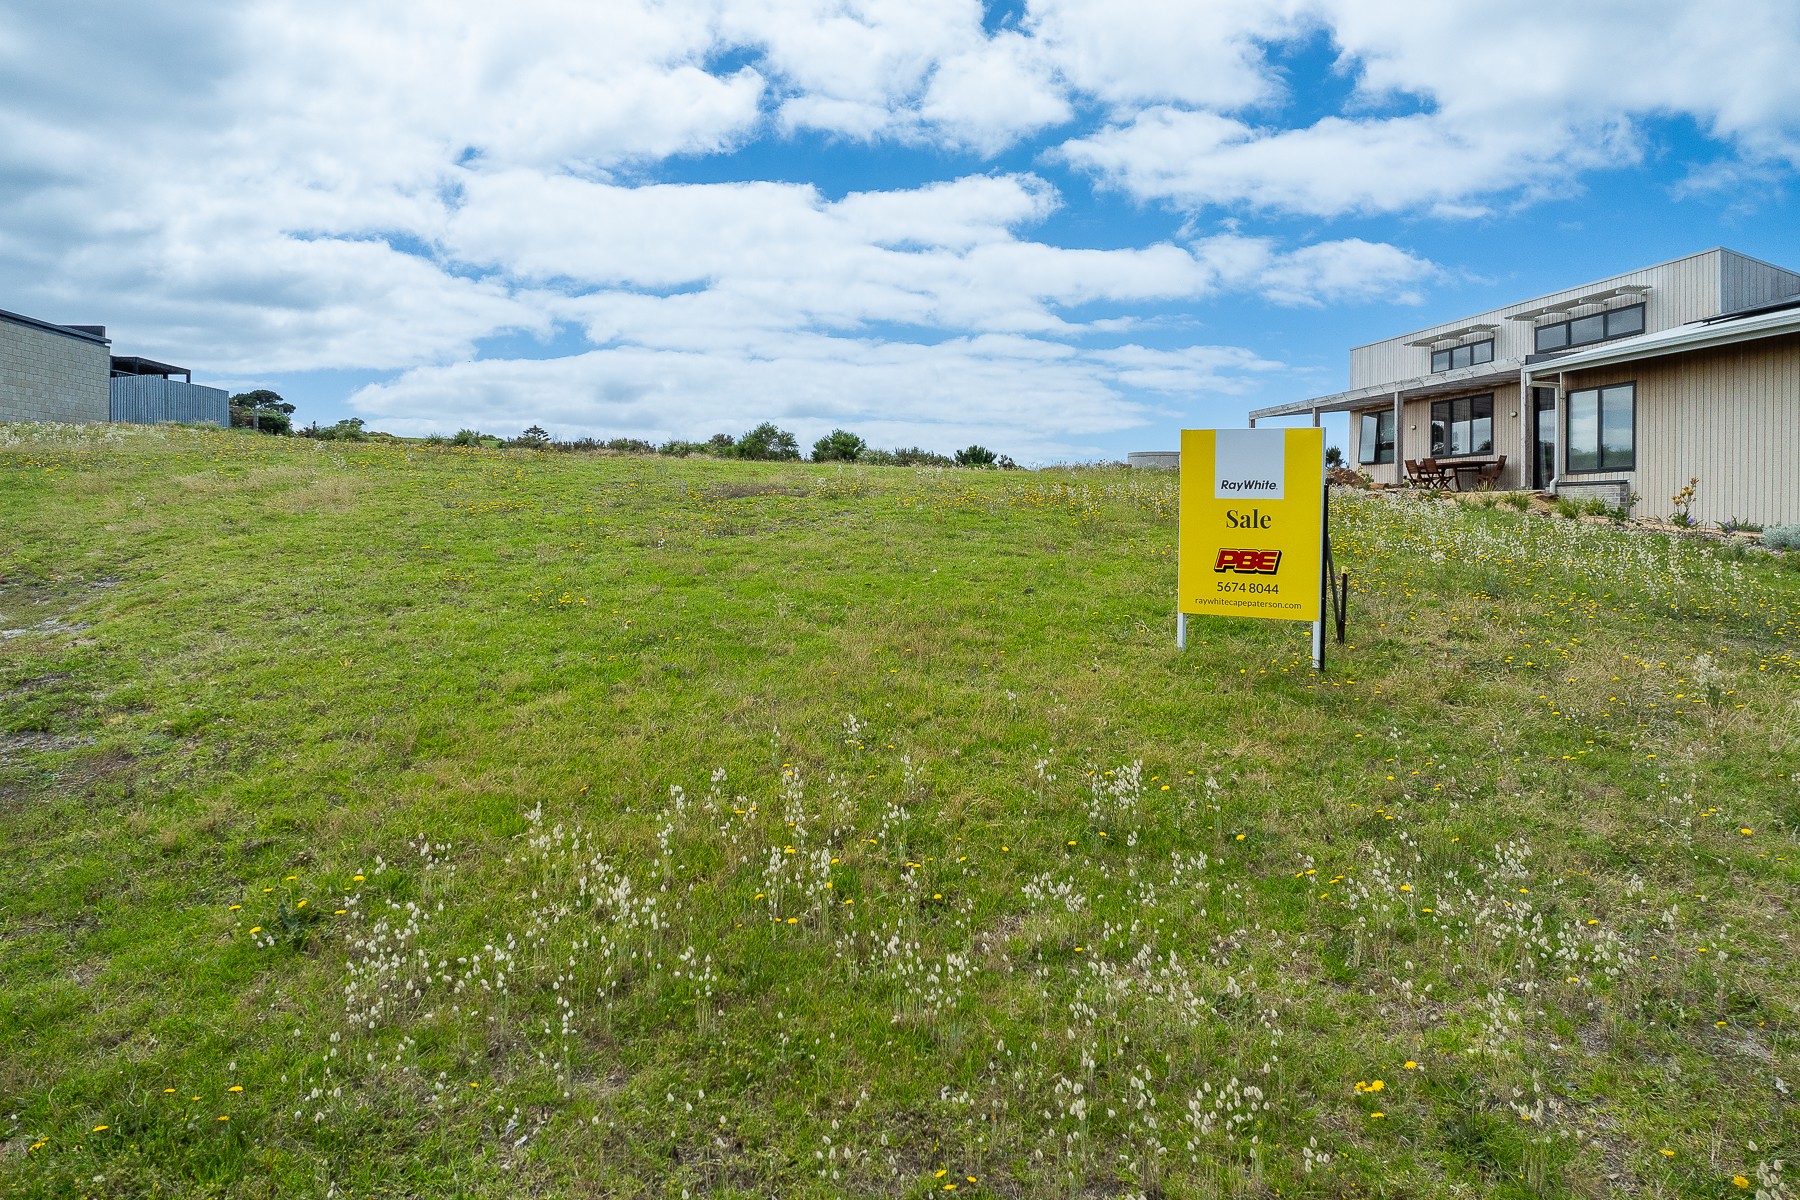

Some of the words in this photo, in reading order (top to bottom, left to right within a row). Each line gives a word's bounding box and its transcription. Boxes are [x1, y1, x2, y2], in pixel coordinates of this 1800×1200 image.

[1225, 508, 1272, 530] Sale
[1214, 548, 1282, 575] PBE
[1216, 581, 1246, 593] 5674
[1248, 583, 1279, 595] 8044
[1195, 597, 1302, 610] raywhitecapepaterson.com
